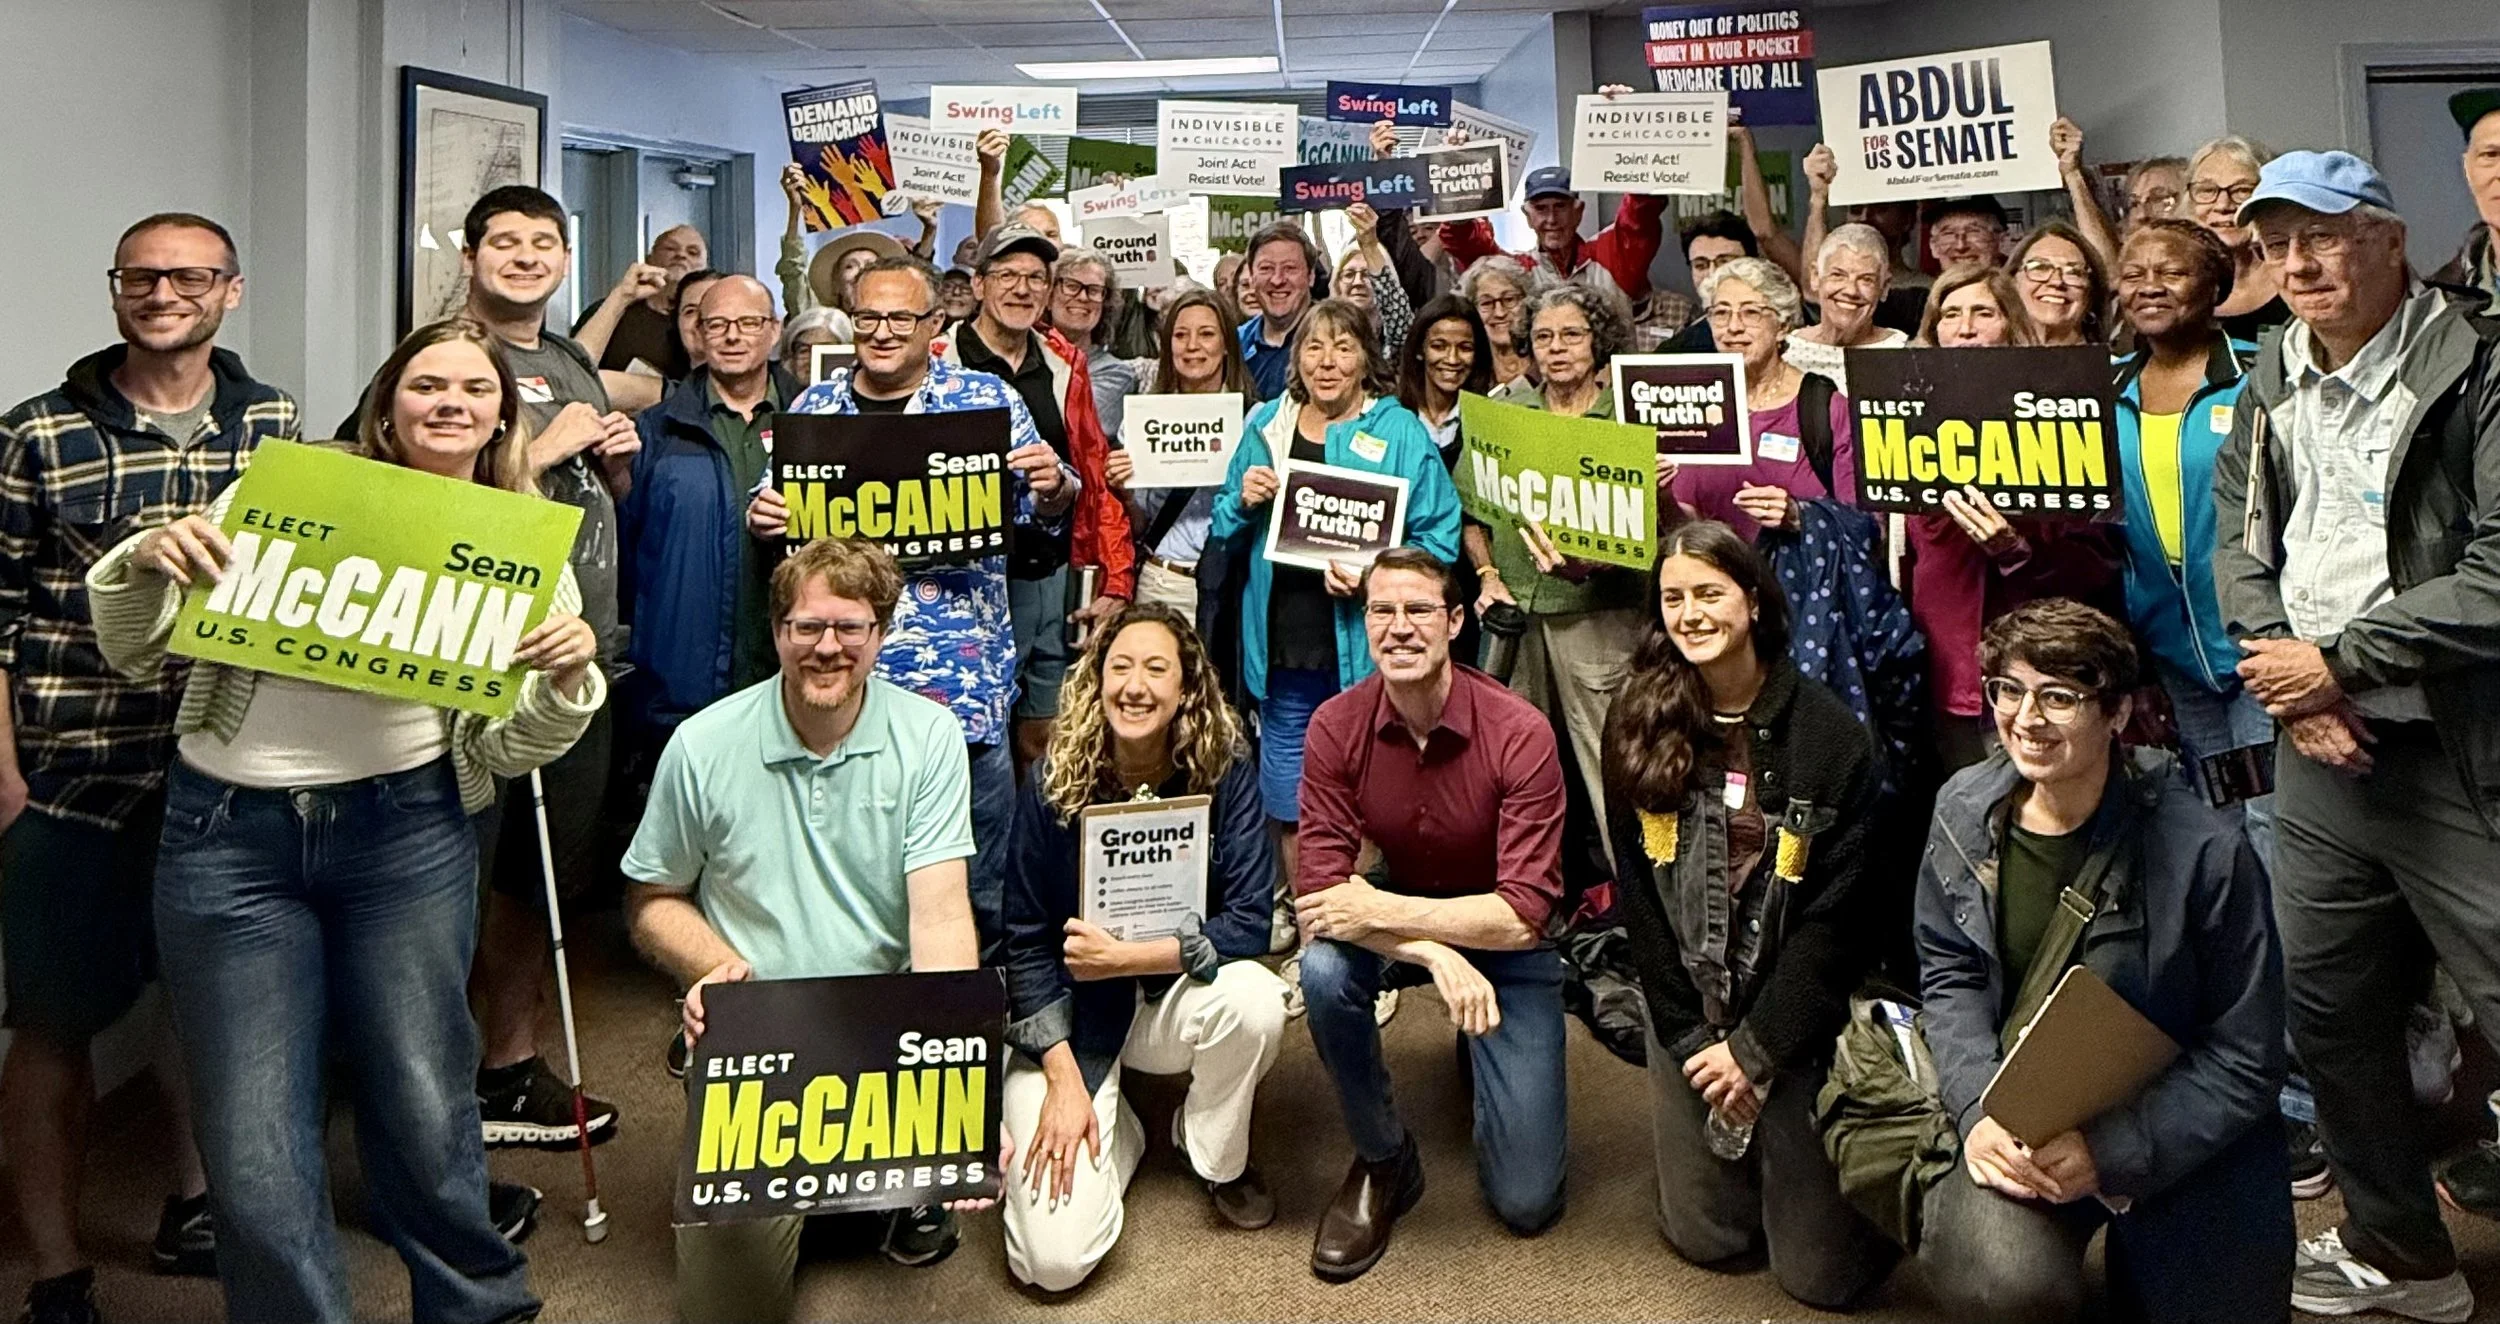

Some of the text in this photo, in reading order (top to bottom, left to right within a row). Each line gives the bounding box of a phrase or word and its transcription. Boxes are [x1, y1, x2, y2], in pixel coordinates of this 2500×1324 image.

[1650, 10, 1799, 40] MONEY OUT OF POLITICS
[1652, 36, 1800, 63] MONEY IN YOUR POCKET
[1656, 61, 1802, 92] MEDICARE FOR ALL
[1859, 58, 2014, 129] ABDUL
[788, 94, 878, 127] DEMAND
[1588, 111, 1715, 124] INDIVISIBLE
[792, 113, 879, 143] DEMOCRACY
[1171, 118, 1285, 133] INDIVISIBLE
[1611, 130, 1687, 139] CHICAGO
[892, 129, 975, 151] INDIVISIB
[1194, 135, 1262, 146] CHICAGO
[1863, 120, 2018, 169] FOR SENATE
[1197, 156, 1257, 170] Join! Act!
[1428, 157, 1494, 179] Ground
[1614, 152, 1680, 166] Join! Act!
[1865, 150, 1892, 170] US
[1188, 172, 1266, 186] Resist! Vote!
[1430, 175, 1480, 194] Truth
[1603, 170, 1691, 184] Resist! Vote!
[1093, 232, 1157, 249] Ground
[1631, 380, 1724, 404] Ground
[1860, 391, 2100, 419] ELECT Sean
[1144, 417, 1224, 436] Ground
[1634, 402, 1704, 425] Truth
[1146, 437, 1206, 454] Truth
[1861, 418, 2108, 487] McCANN
[782, 452, 1000, 480] ELECT Sean
[1579, 456, 1644, 485] Sean
[783, 472, 1002, 539] McCANN
[1294, 486, 1386, 522] Ground
[1471, 449, 1645, 542] McCANN
[1866, 485, 1910, 503] U.S.
[1296, 505, 1361, 539] Truth
[242, 508, 541, 589] ELECT Sean
[883, 531, 1004, 558] NGRESS
[205, 530, 535, 673] McCANN
[195, 619, 503, 698] U.S. CONGRESS
[1100, 821, 1194, 848] Ground
[1102, 844, 1172, 868] Truth
[706, 1031, 987, 1078] ELECT Sean
[696, 1066, 987, 1174] McCANN
[691, 1162, 985, 1206] U.S. CONGRESS
